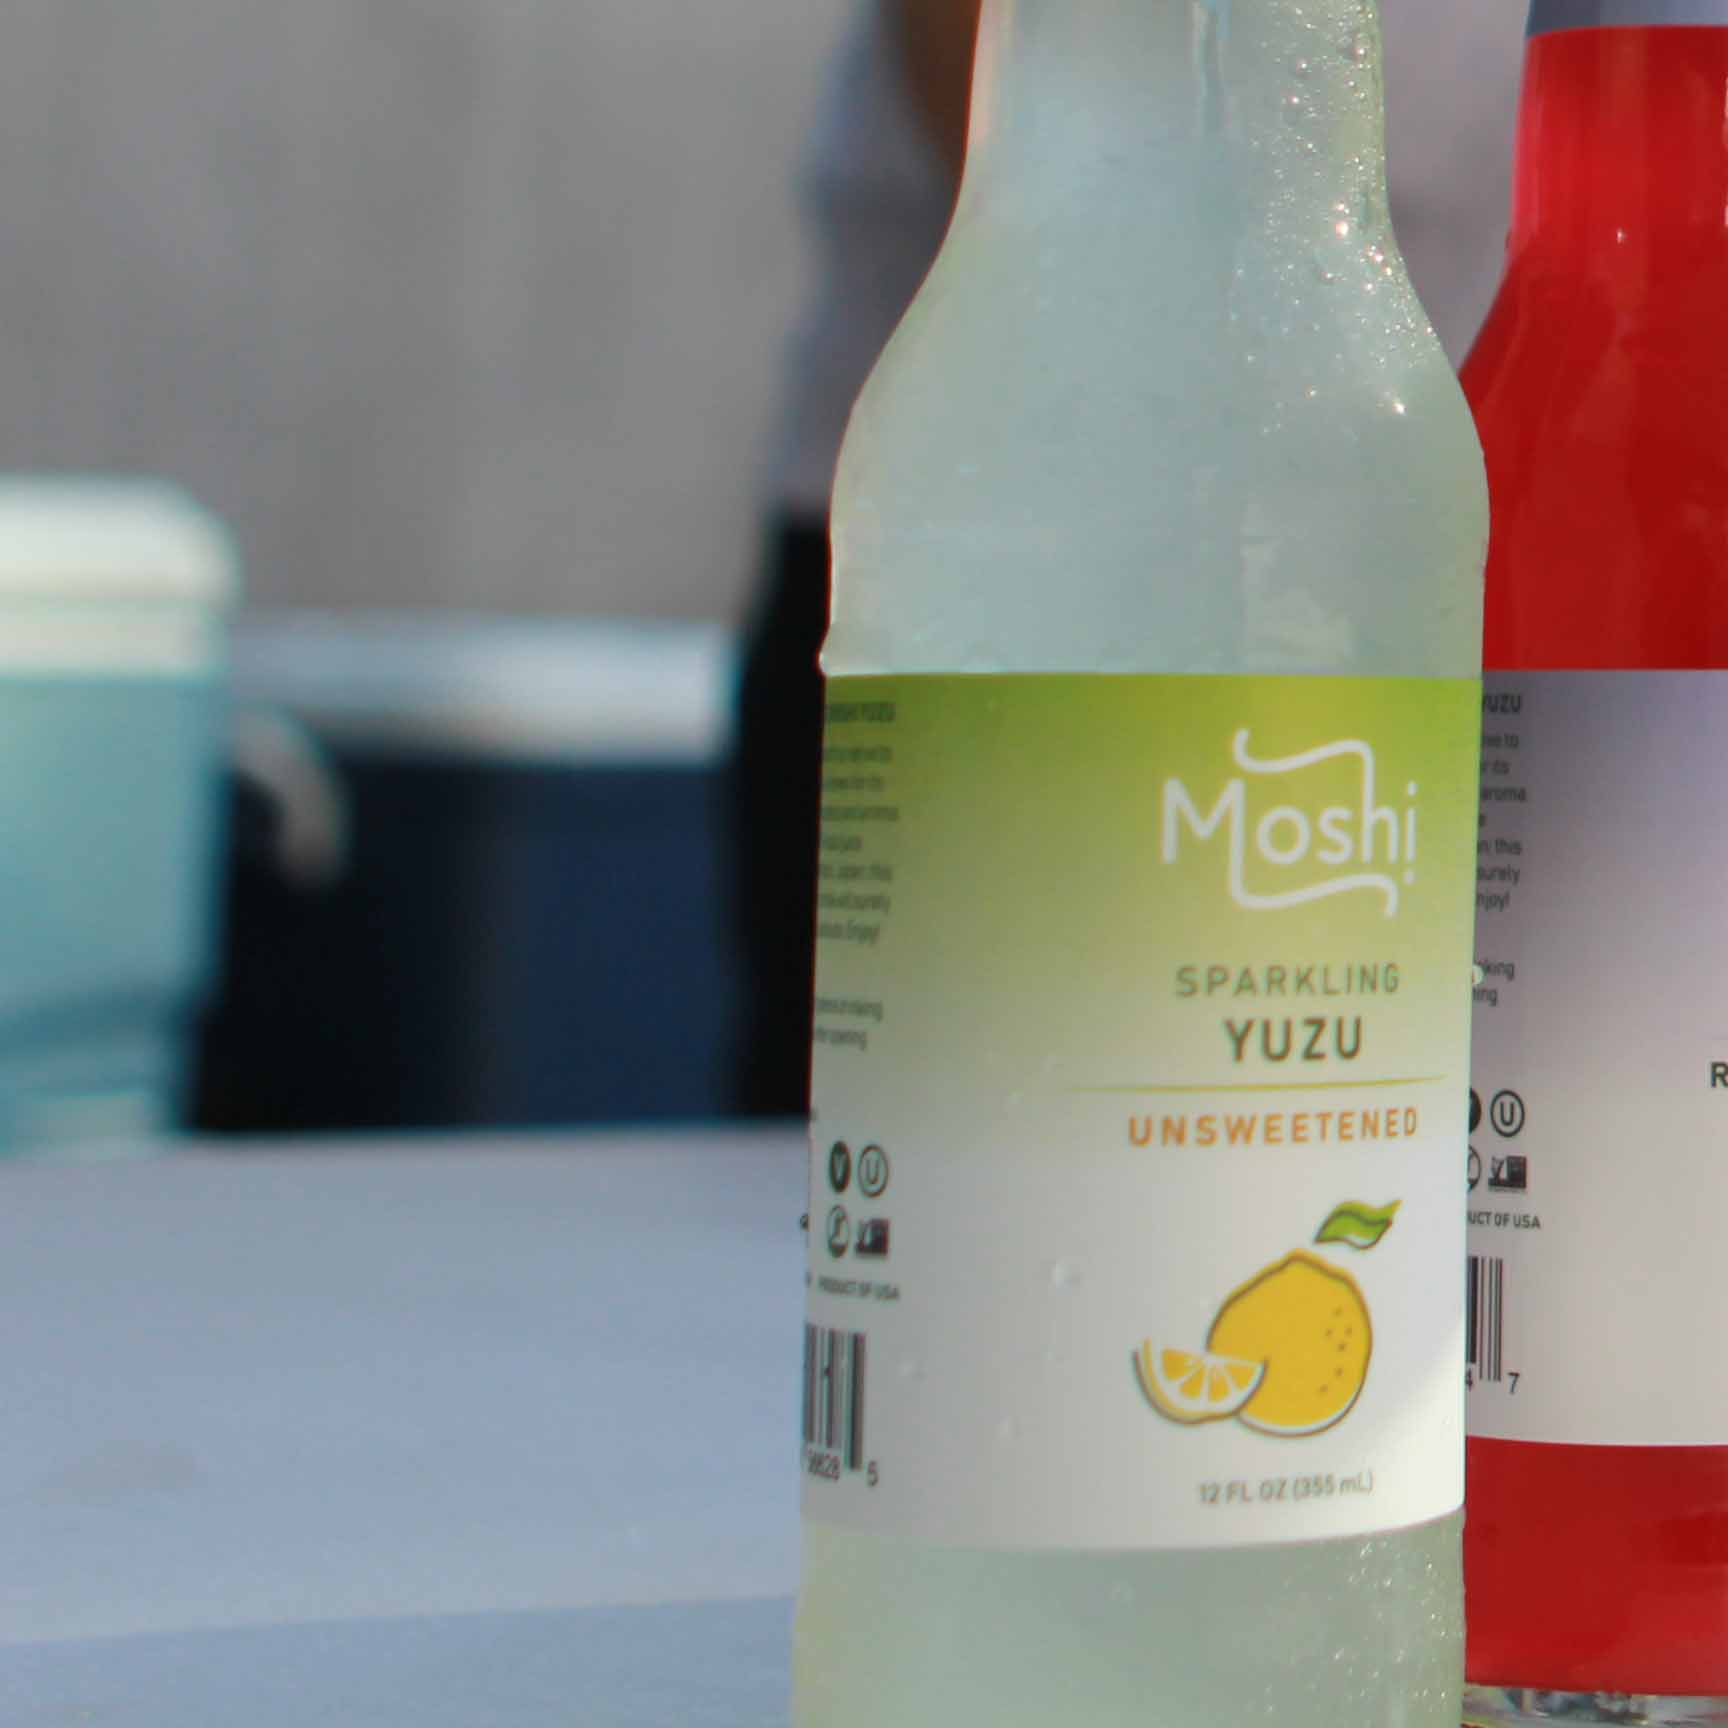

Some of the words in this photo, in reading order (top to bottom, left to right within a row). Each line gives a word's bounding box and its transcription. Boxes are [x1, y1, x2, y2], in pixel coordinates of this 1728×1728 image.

[1162, 728, 1418, 917] Moshi
[1476, 891, 1510, 913] njoy!
[1175, 962, 1400, 997] SPARKLING
[1223, 1015, 1364, 1062] YUZU
[1128, 1106, 1418, 1147] UNSWEETENED
[1494, 1212, 1511, 1227] OF
[1512, 1214, 1541, 1230] USA
[1198, 1482, 1220, 1504] 12
[1226, 1481, 1251, 1504] FL
[1260, 1478, 1288, 1501] OZ
